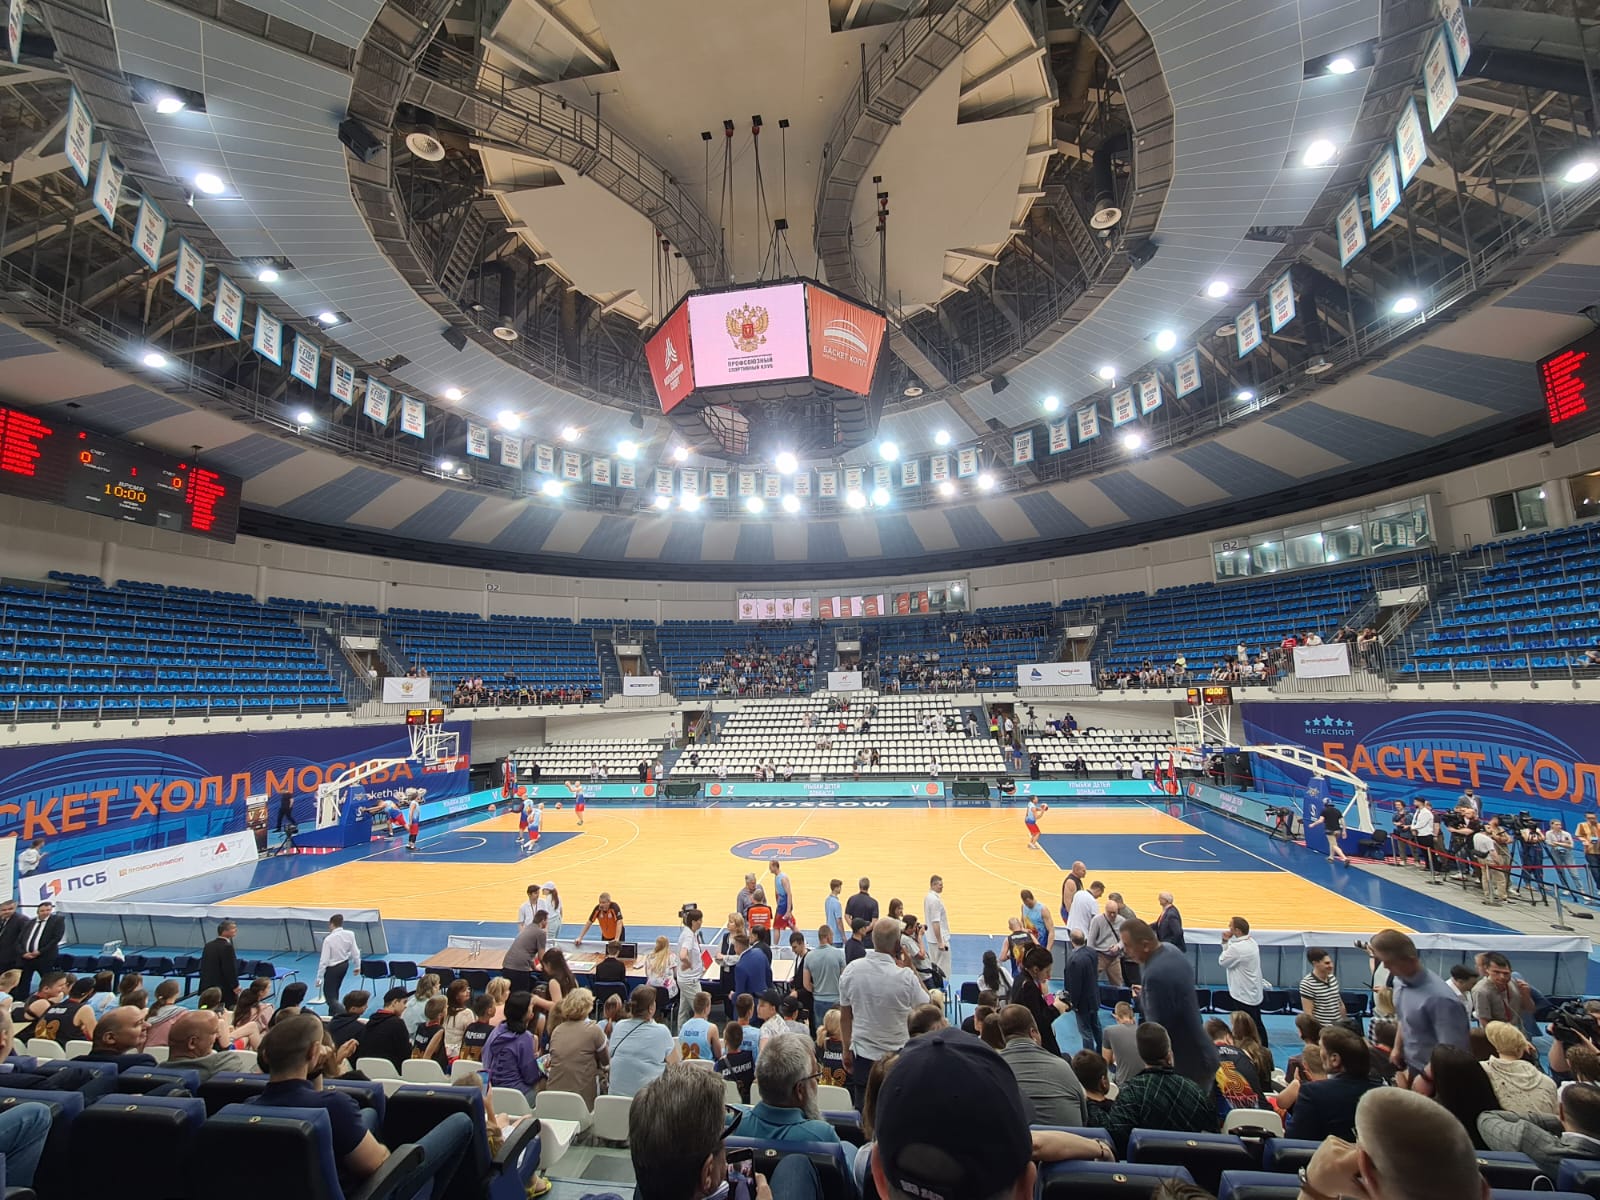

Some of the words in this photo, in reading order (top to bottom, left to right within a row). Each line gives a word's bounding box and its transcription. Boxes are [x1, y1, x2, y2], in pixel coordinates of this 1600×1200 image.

[728, 357, 773, 367] ПРОФСОЮЗНЫЙ
[104, 483, 148, 503] 10:00
[1305, 728, 1355, 736] МЕГАСПОРТ
[1322, 742, 1486, 788] БАСКЕТ
[130, 773, 251, 820] ХОЛЛ
[68, 871, 107, 891] ПСБ
